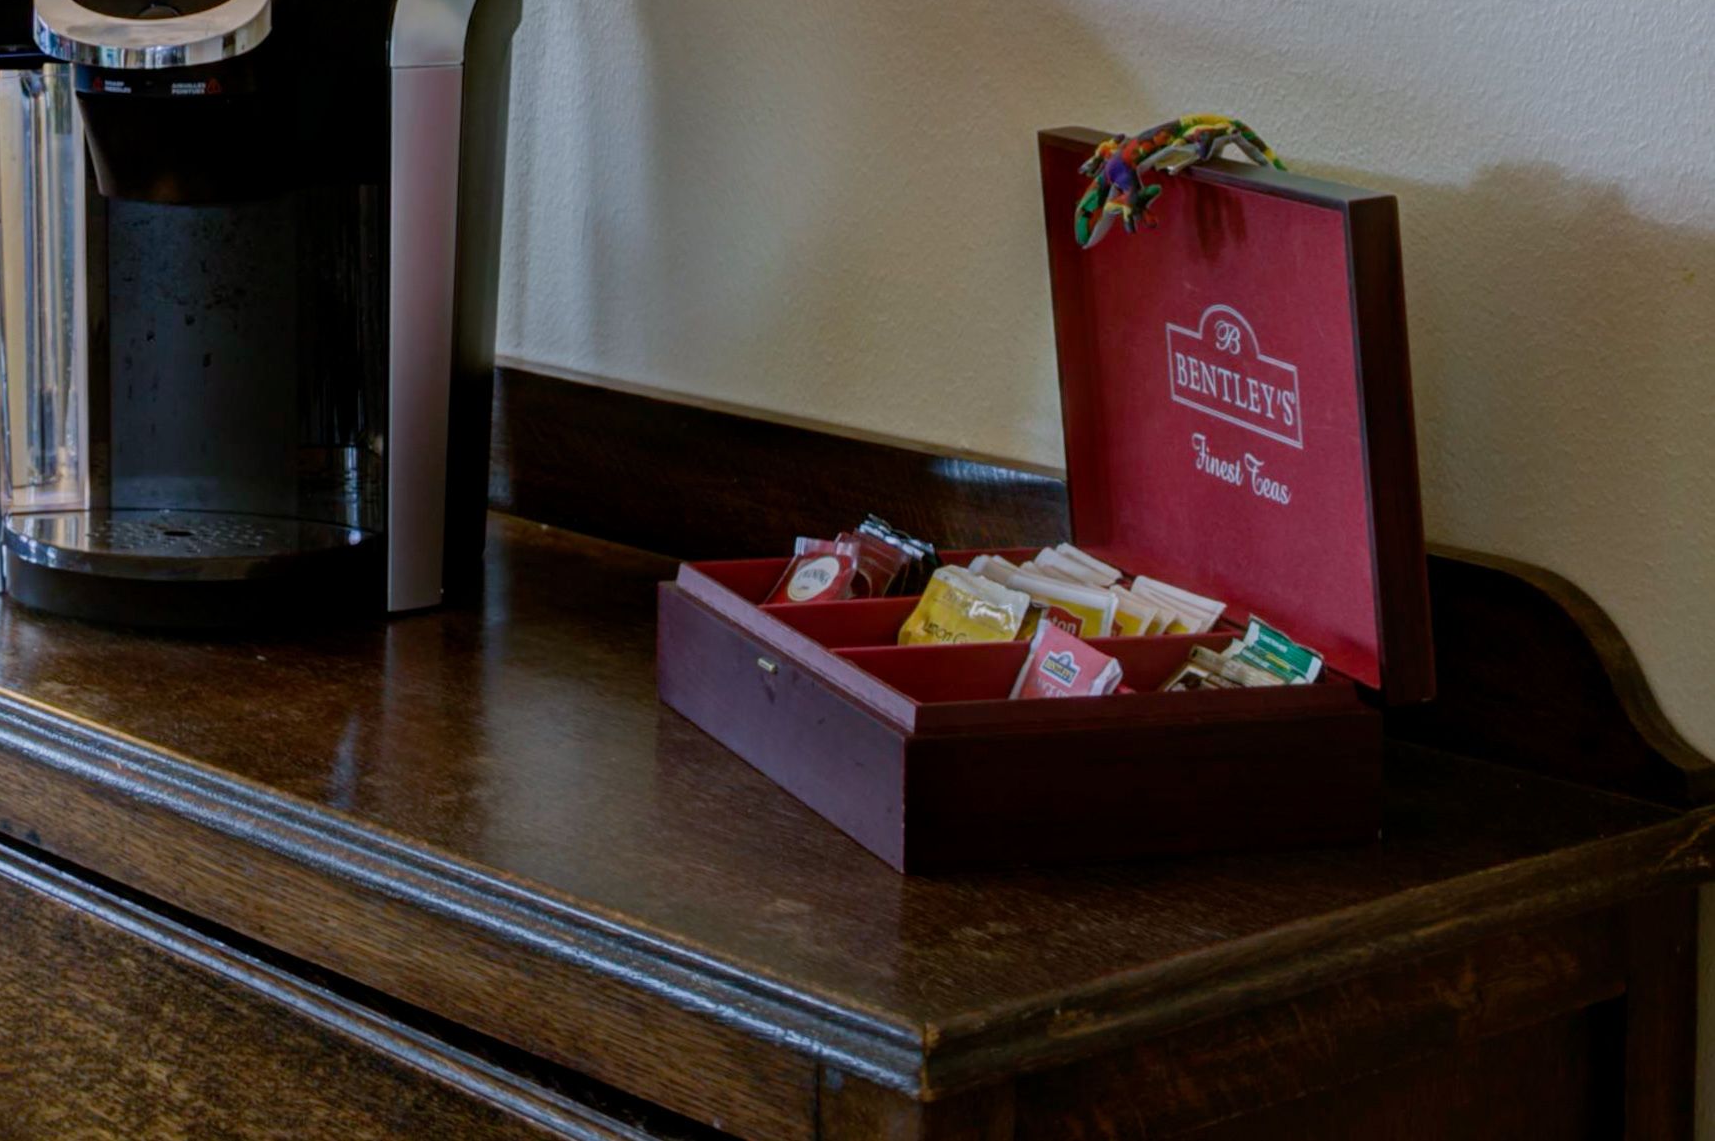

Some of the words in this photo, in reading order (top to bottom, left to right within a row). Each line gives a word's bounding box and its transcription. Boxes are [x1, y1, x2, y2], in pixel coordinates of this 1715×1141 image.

[1214, 320, 1241, 355] B
[1175, 352, 1295, 426] BENTLEY'S
[1191, 432, 1244, 486] Finest
[1244, 452, 1292, 505] Teas
